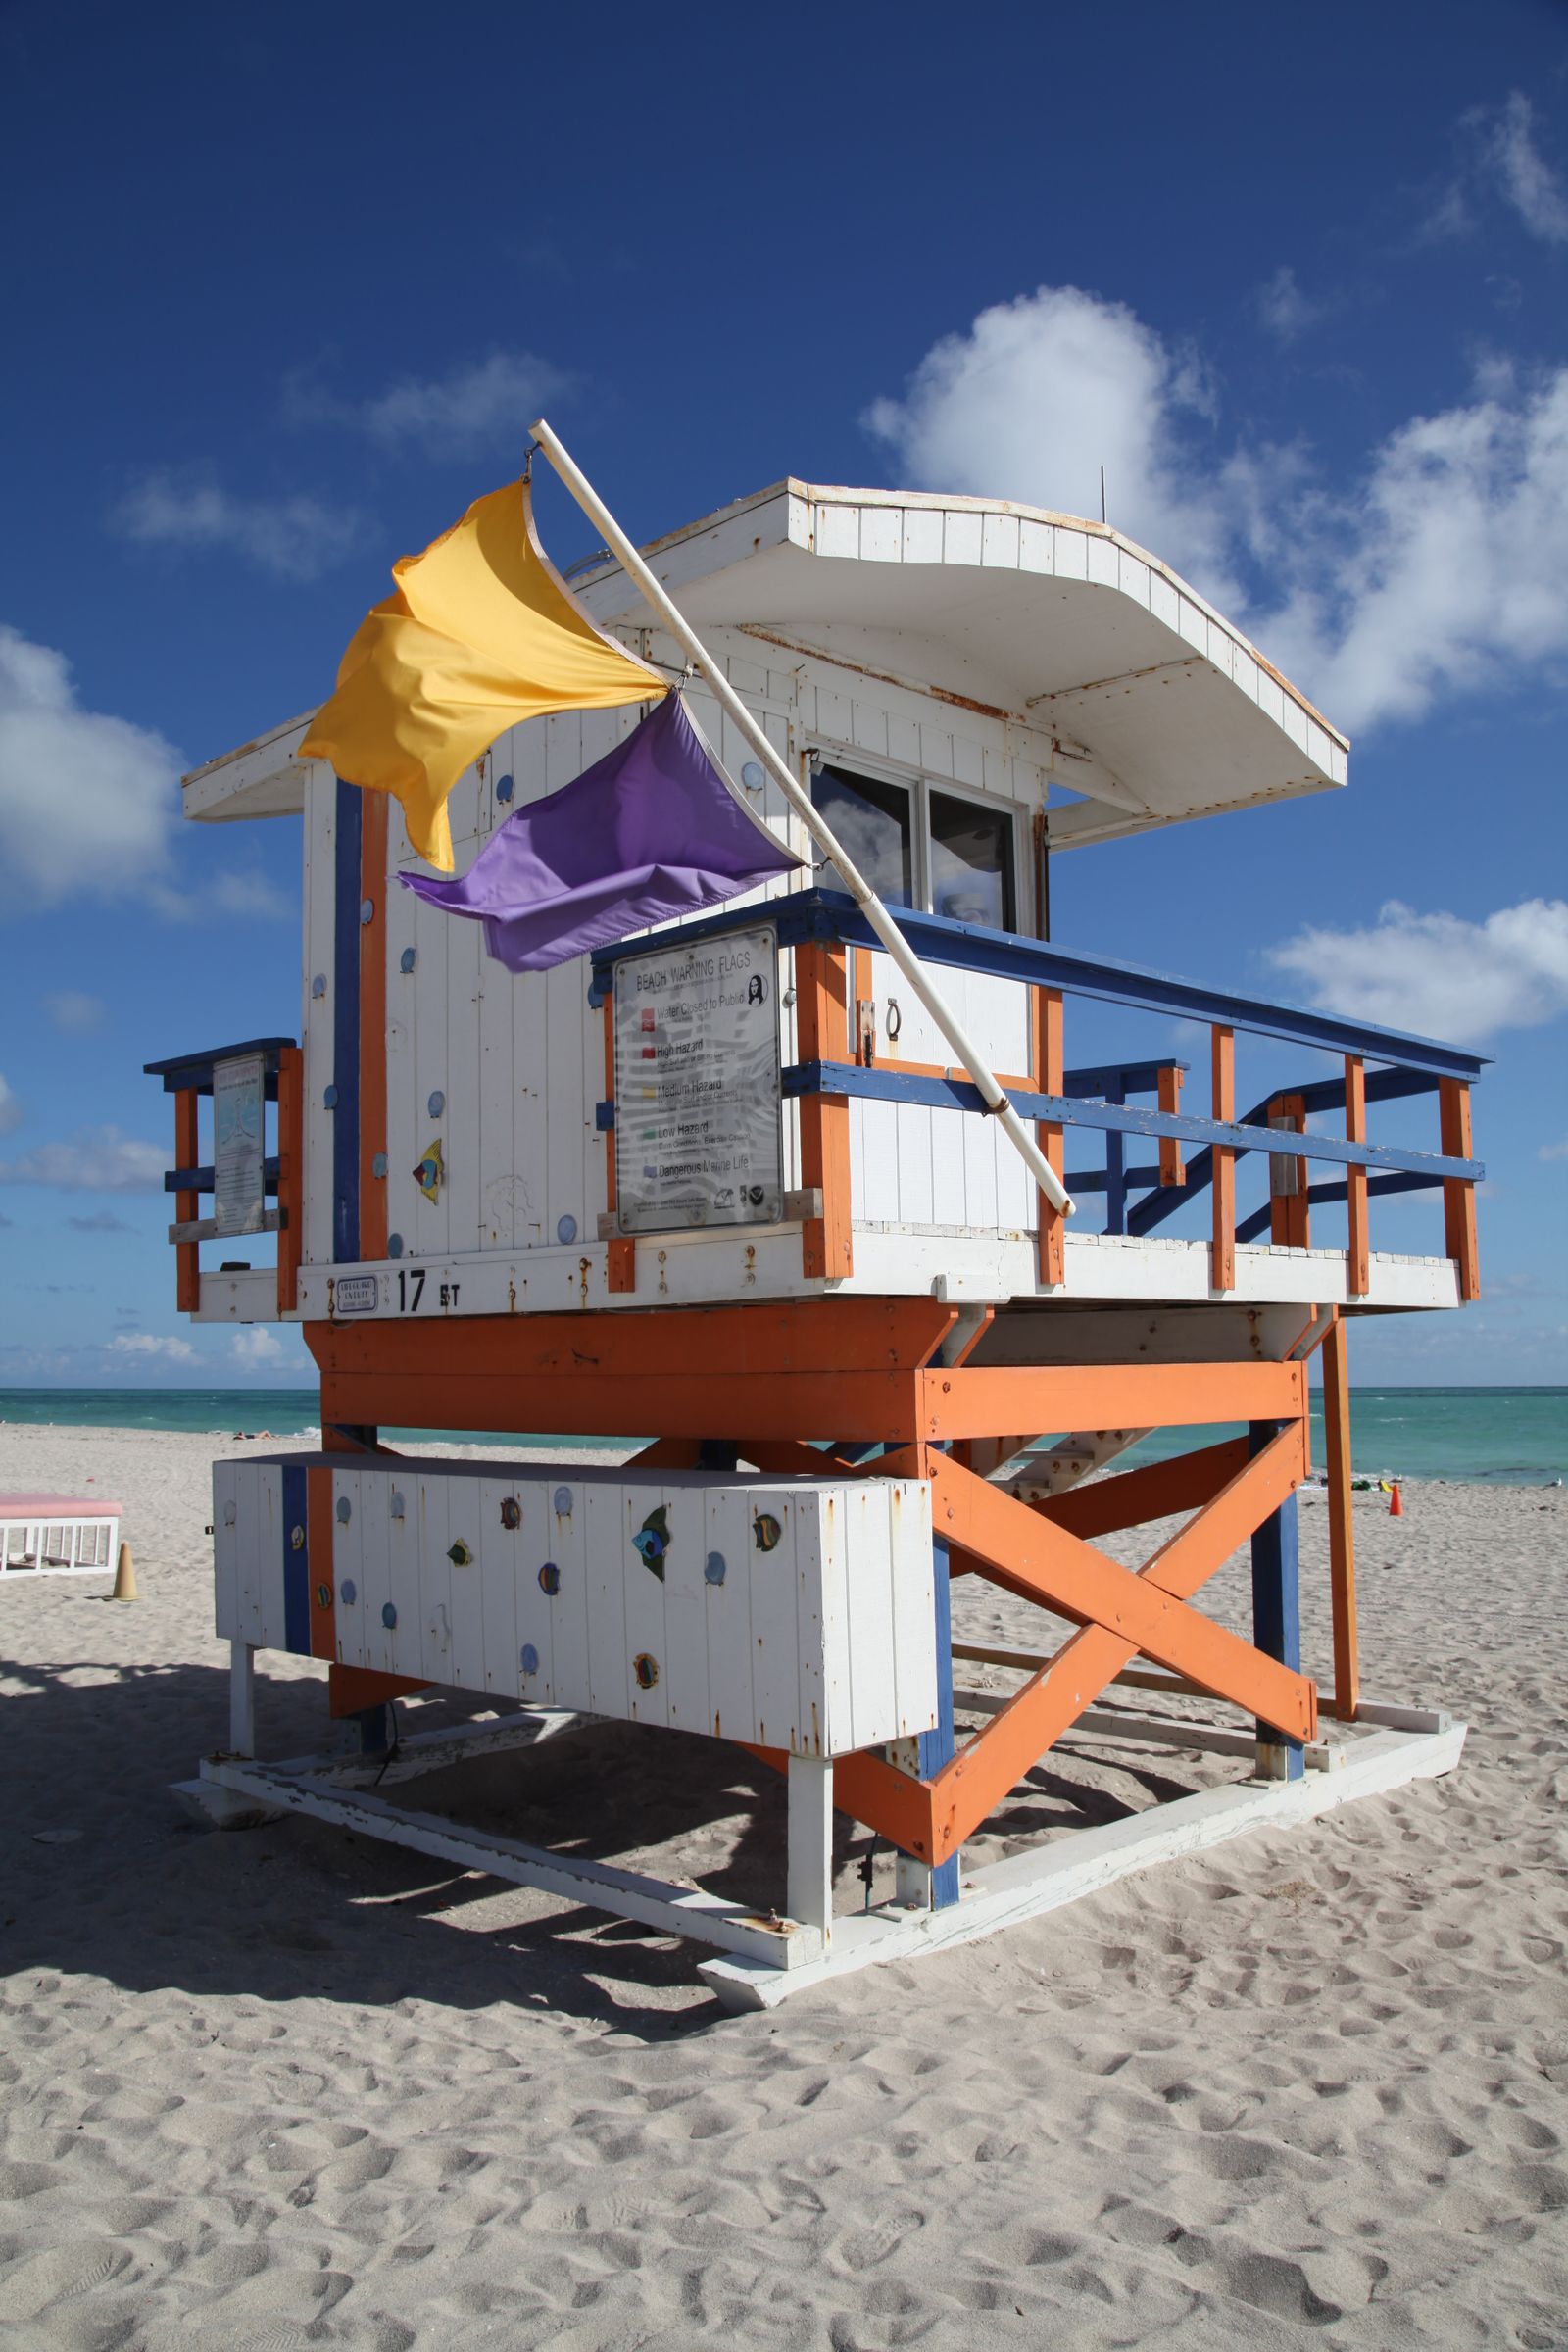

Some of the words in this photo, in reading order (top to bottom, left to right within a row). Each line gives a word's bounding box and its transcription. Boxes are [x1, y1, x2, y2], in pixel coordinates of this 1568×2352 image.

[636, 970, 667, 992] BEACH
[670, 958, 714, 983] WARNING
[718, 950, 751, 973] FLAGS
[657, 1004, 679, 1020] Water
[680, 998, 708, 1015] Closed
[710, 998, 717, 1009] to
[718, 992, 745, 1007] Public
[657, 1042, 674, 1059] High
[675, 1038, 704, 1054] Hazard
[658, 1082, 690, 1099] Medium
[691, 1076, 722, 1093] Hazard
[658, 1126, 675, 1139] Low
[677, 1120, 709, 1136] Hazard
[659, 1162, 702, 1179] Dangerous
[703, 1159, 731, 1174] Marine
[733, 1154, 749, 1170] Life
[397, 1269, 426, 1312] 17
[439, 1284, 461, 1307] ST
